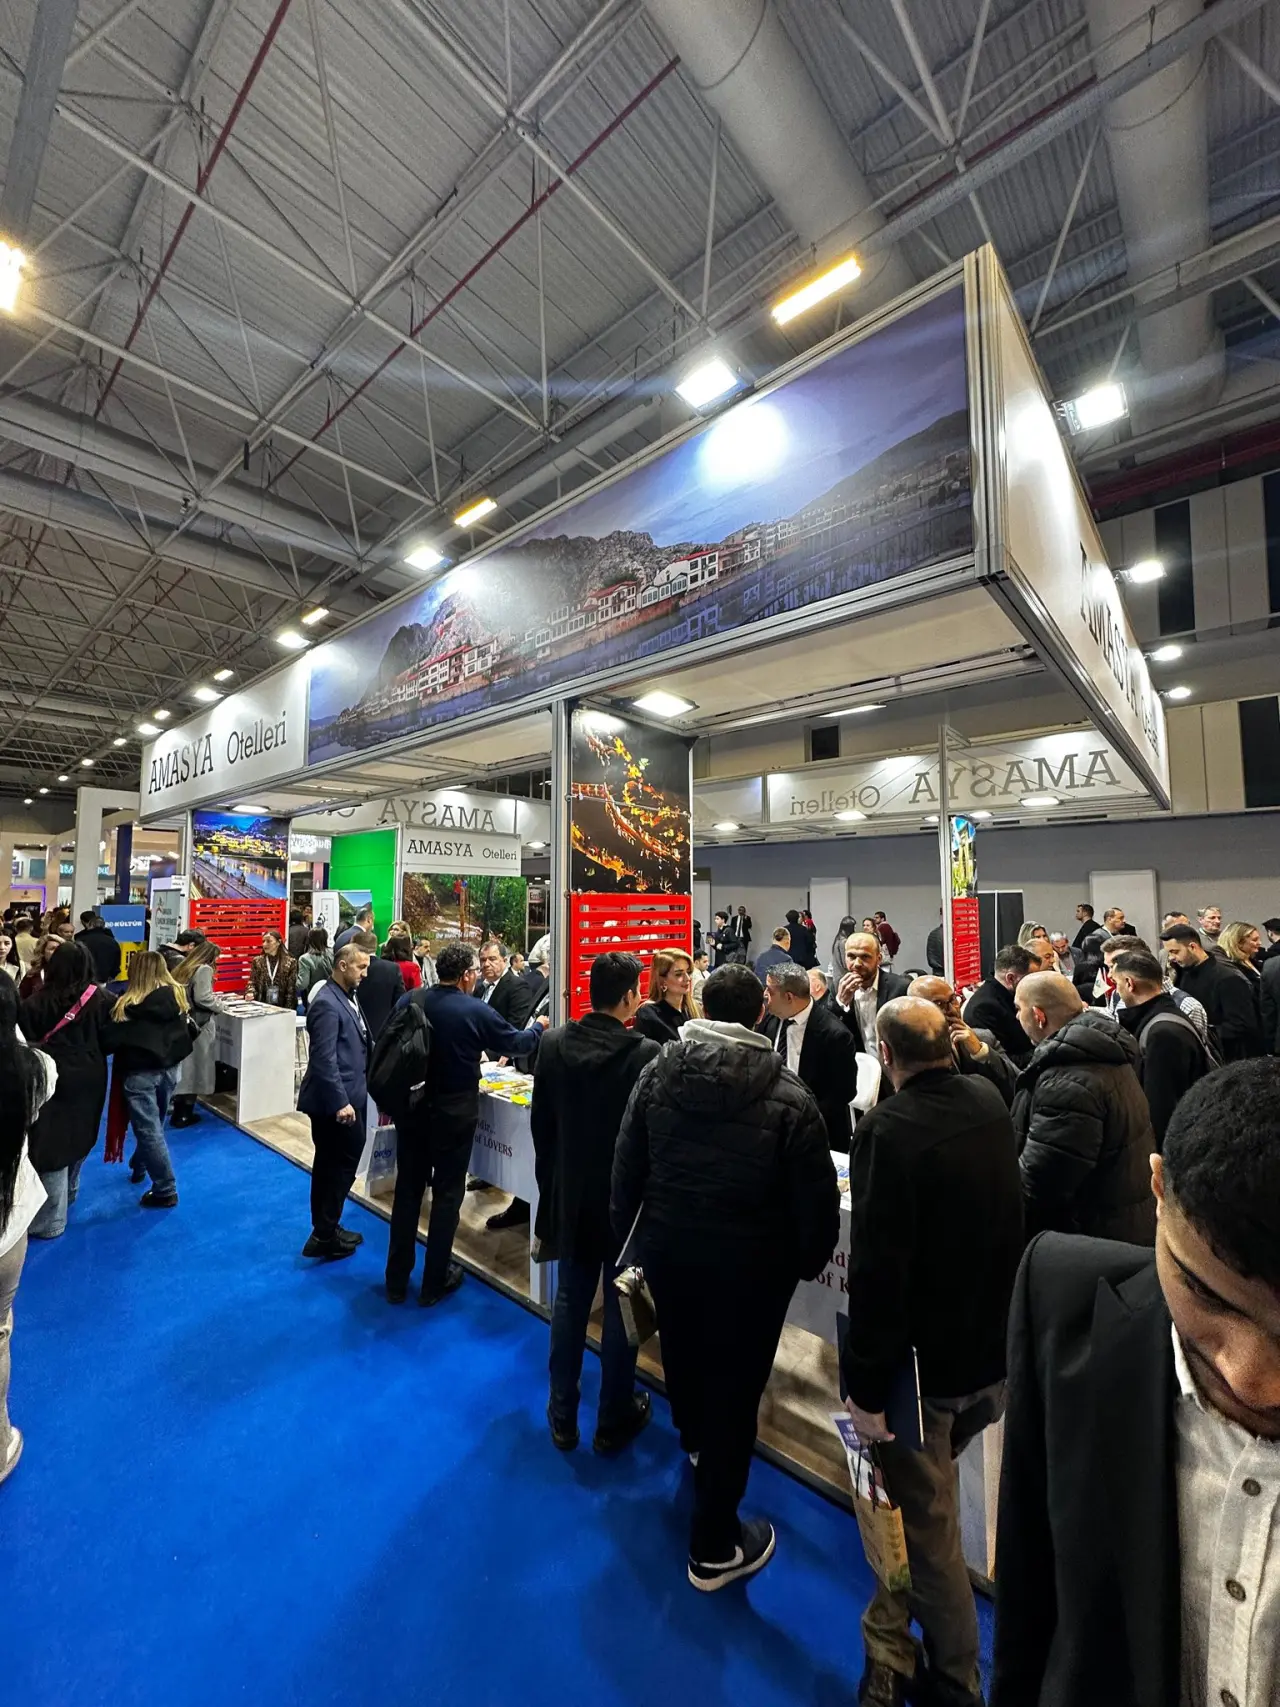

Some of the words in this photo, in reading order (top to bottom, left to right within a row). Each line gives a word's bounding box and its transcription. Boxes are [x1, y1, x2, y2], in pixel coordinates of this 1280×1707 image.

[148, 733, 214, 795] AMASYA
[226, 710, 287, 765] Otelleri
[407, 839, 474, 858] AMASYA
[482, 848, 517, 861] Otelleri
[483, 1134, 513, 1158] LOVERS
[816, 1271, 834, 1289] of
